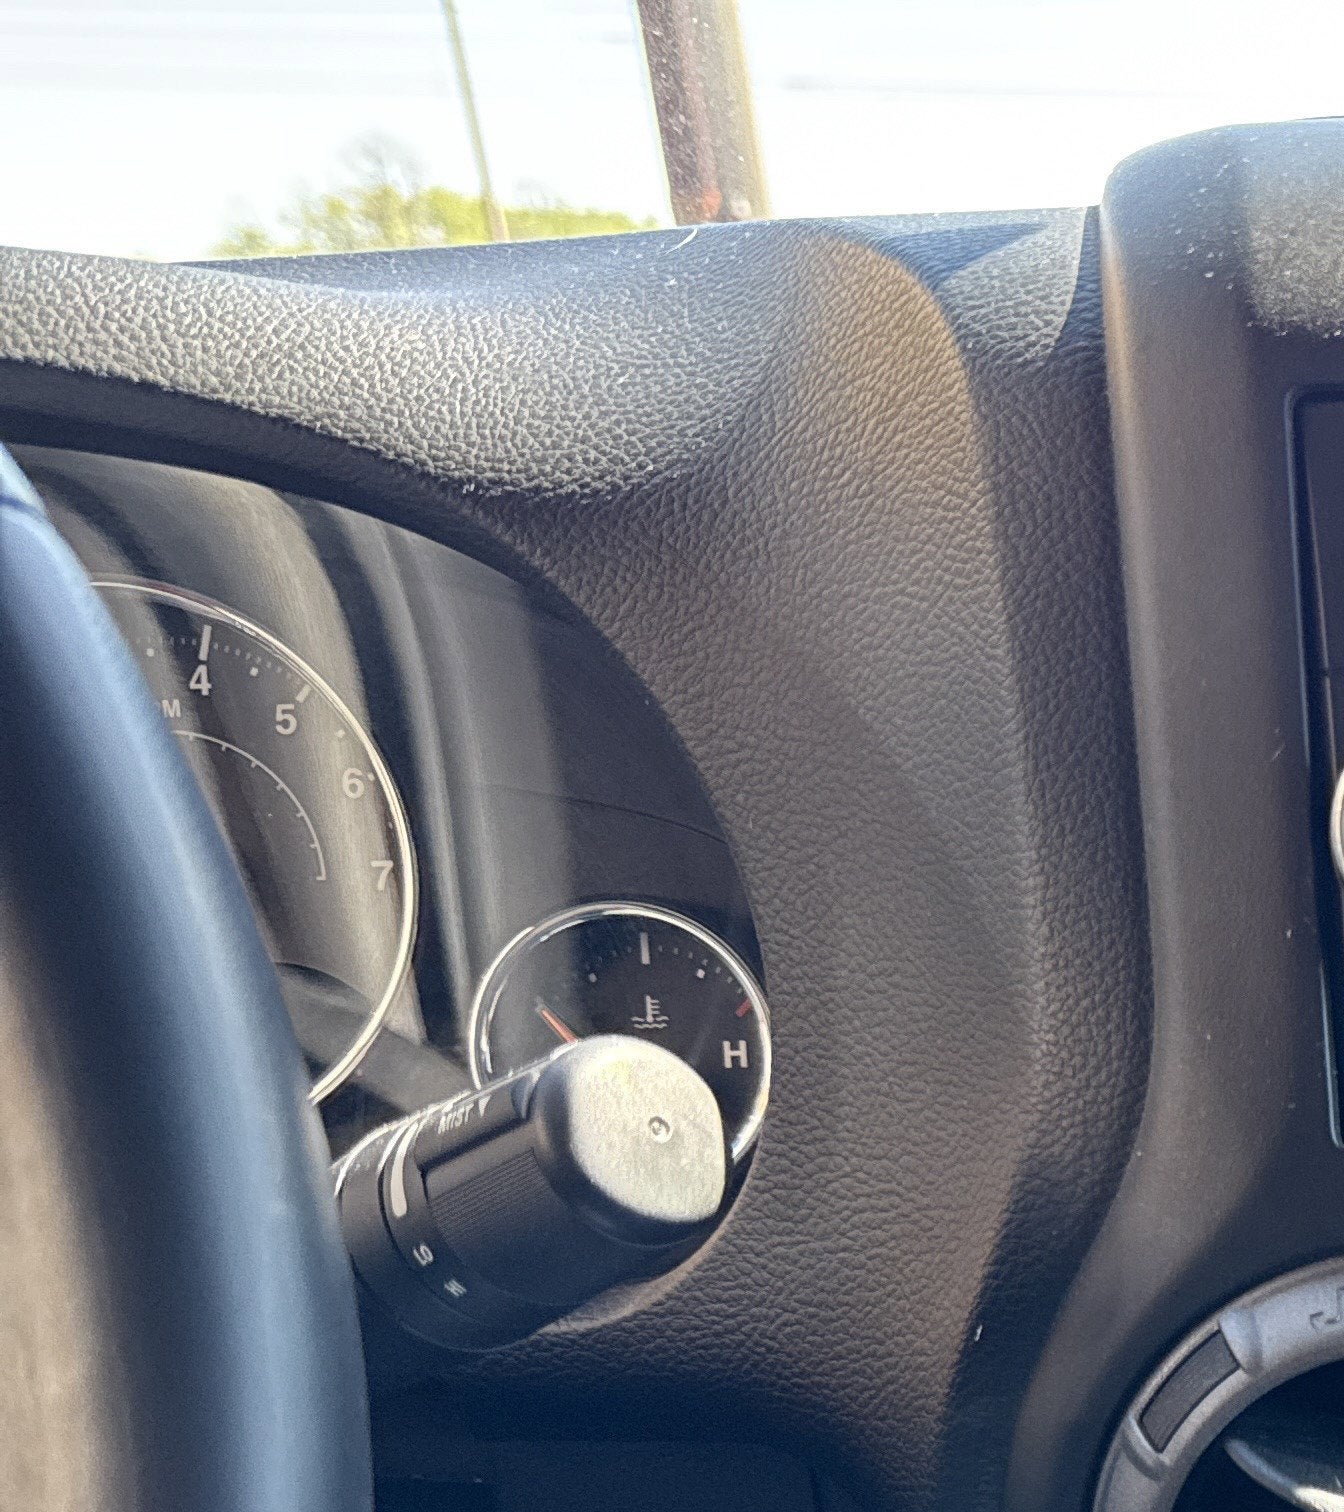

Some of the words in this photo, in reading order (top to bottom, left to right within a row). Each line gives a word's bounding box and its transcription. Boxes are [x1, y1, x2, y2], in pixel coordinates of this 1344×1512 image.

[189, 665, 211, 696] 4
[275, 703, 297, 735] 5
[342, 767, 364, 799] 6
[371, 860, 393, 891] 7
[723, 1040, 749, 1068] H
